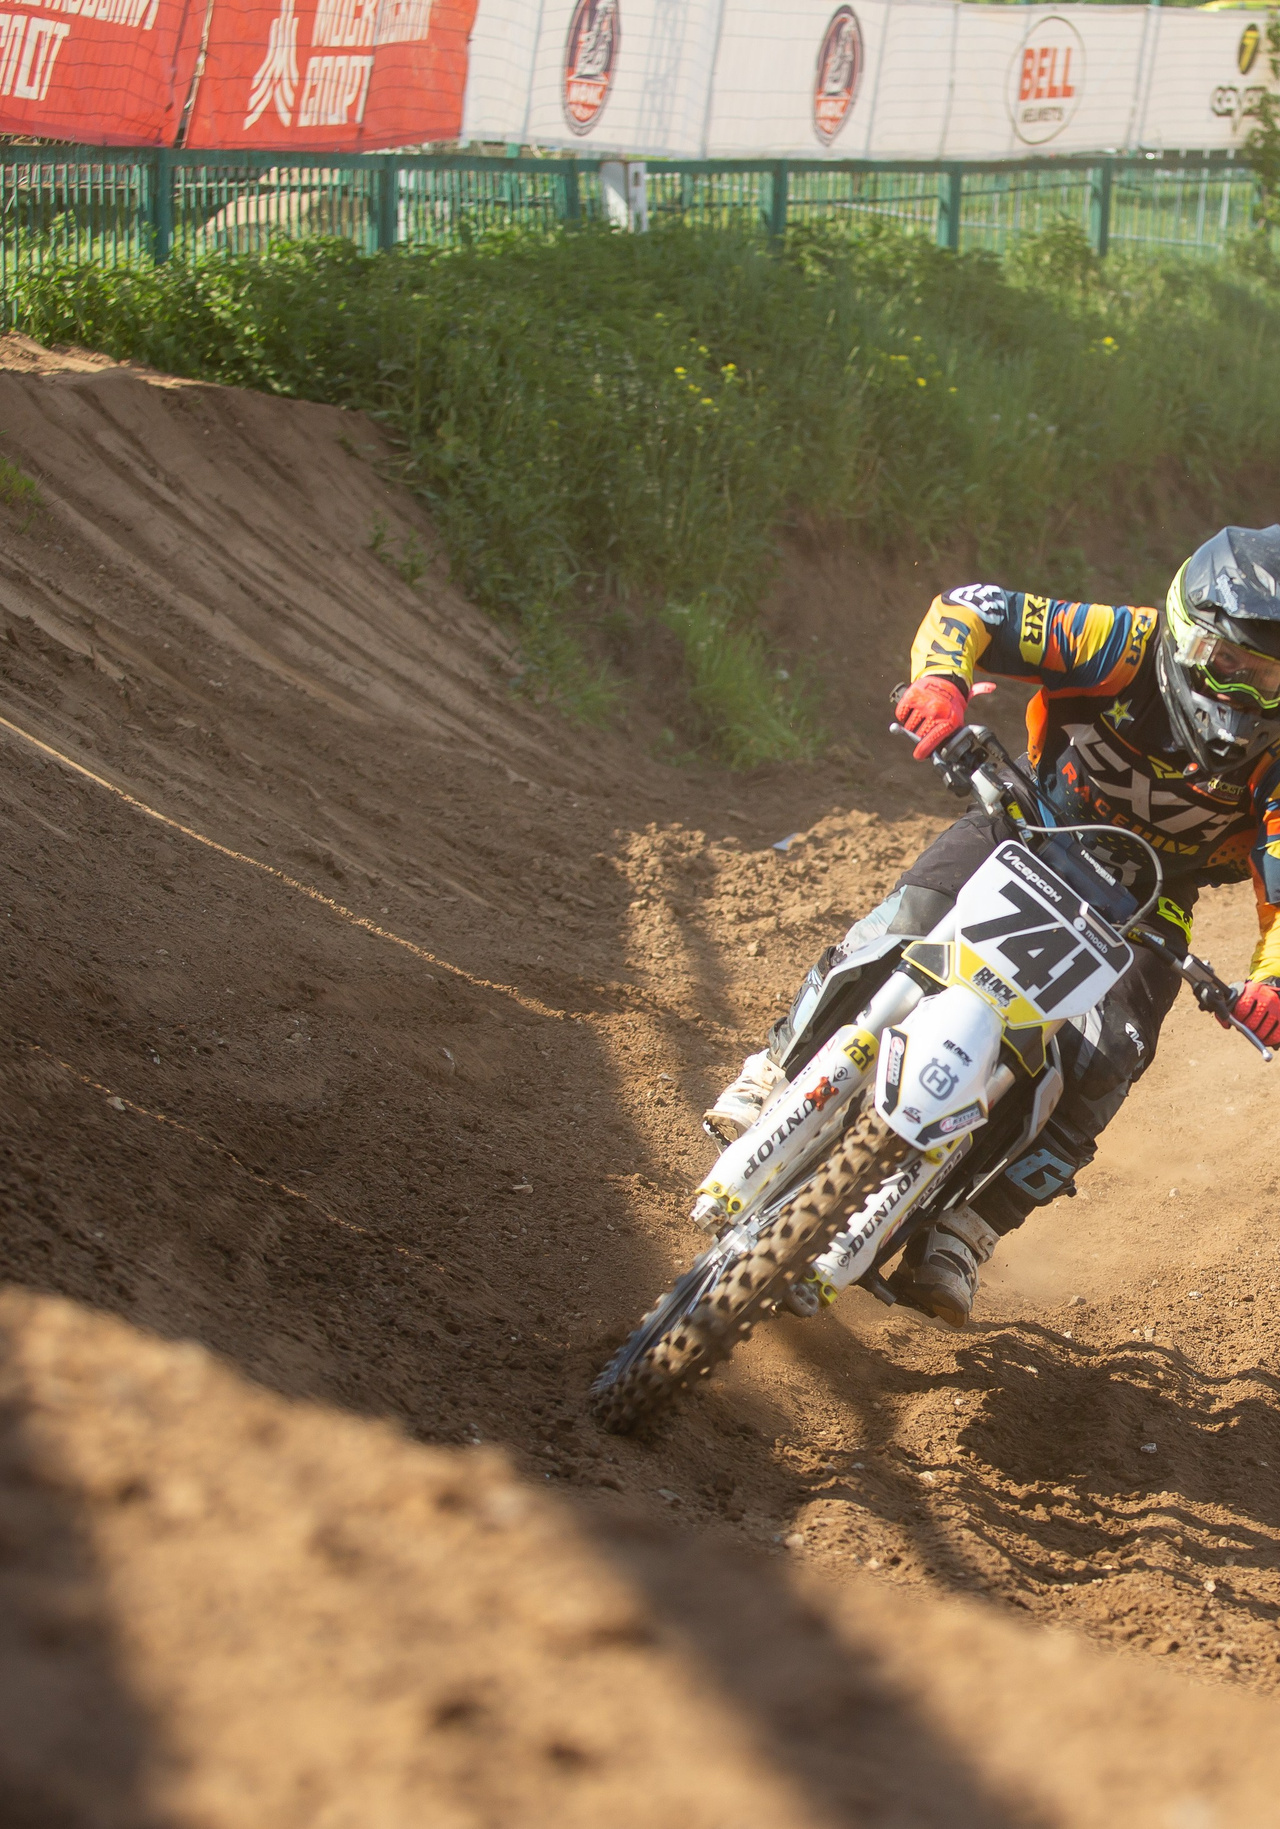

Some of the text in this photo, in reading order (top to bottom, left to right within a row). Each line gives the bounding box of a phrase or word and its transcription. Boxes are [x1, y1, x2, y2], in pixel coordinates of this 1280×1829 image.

[1018, 47, 1075, 101] BELL
[1126, 614, 1151, 667] FXR
[1002, 850, 1063, 903] Исерсон
[960, 880, 1102, 1014] 741
[743, 1099, 818, 1180] UNLOP
[848, 1159, 922, 1257] DUNLOP
